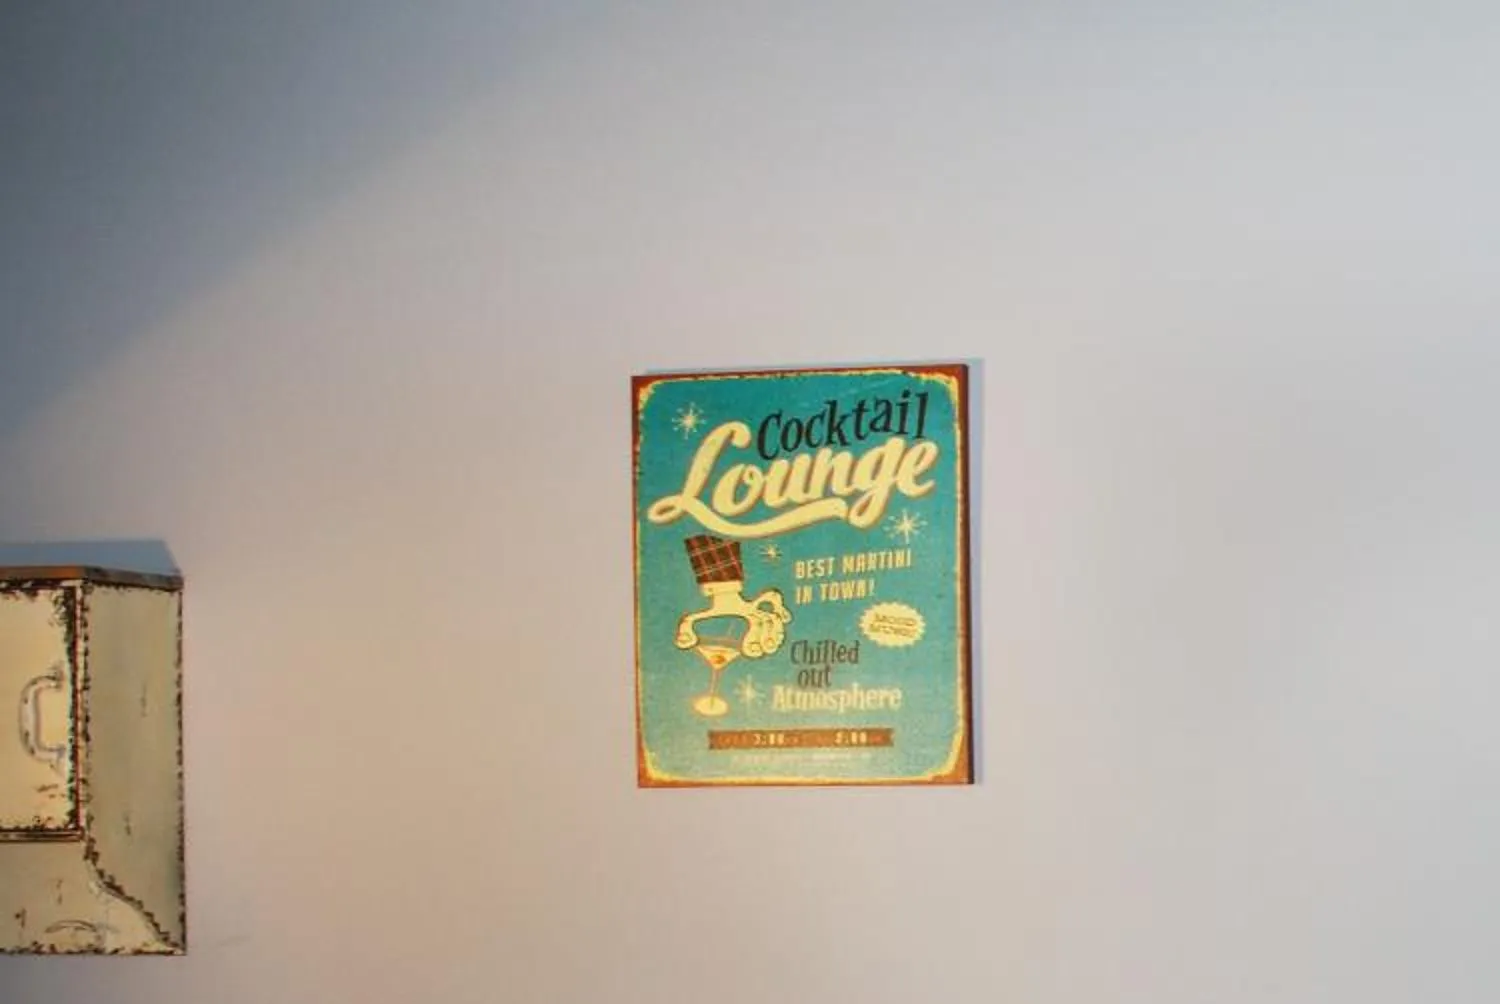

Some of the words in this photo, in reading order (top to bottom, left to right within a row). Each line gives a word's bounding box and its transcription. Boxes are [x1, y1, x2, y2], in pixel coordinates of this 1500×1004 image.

[757, 389, 930, 461] Cocktail
[647, 420, 940, 537] Lounge
[795, 557, 835, 579] BEST
[842, 548, 911, 575] MARTINI
[795, 585, 813, 605] IN
[820, 578, 875, 602] TOWN!
[790, 639, 860, 666] Chilled
[798, 665, 832, 689] out
[771, 682, 902, 714] Atmosphere
